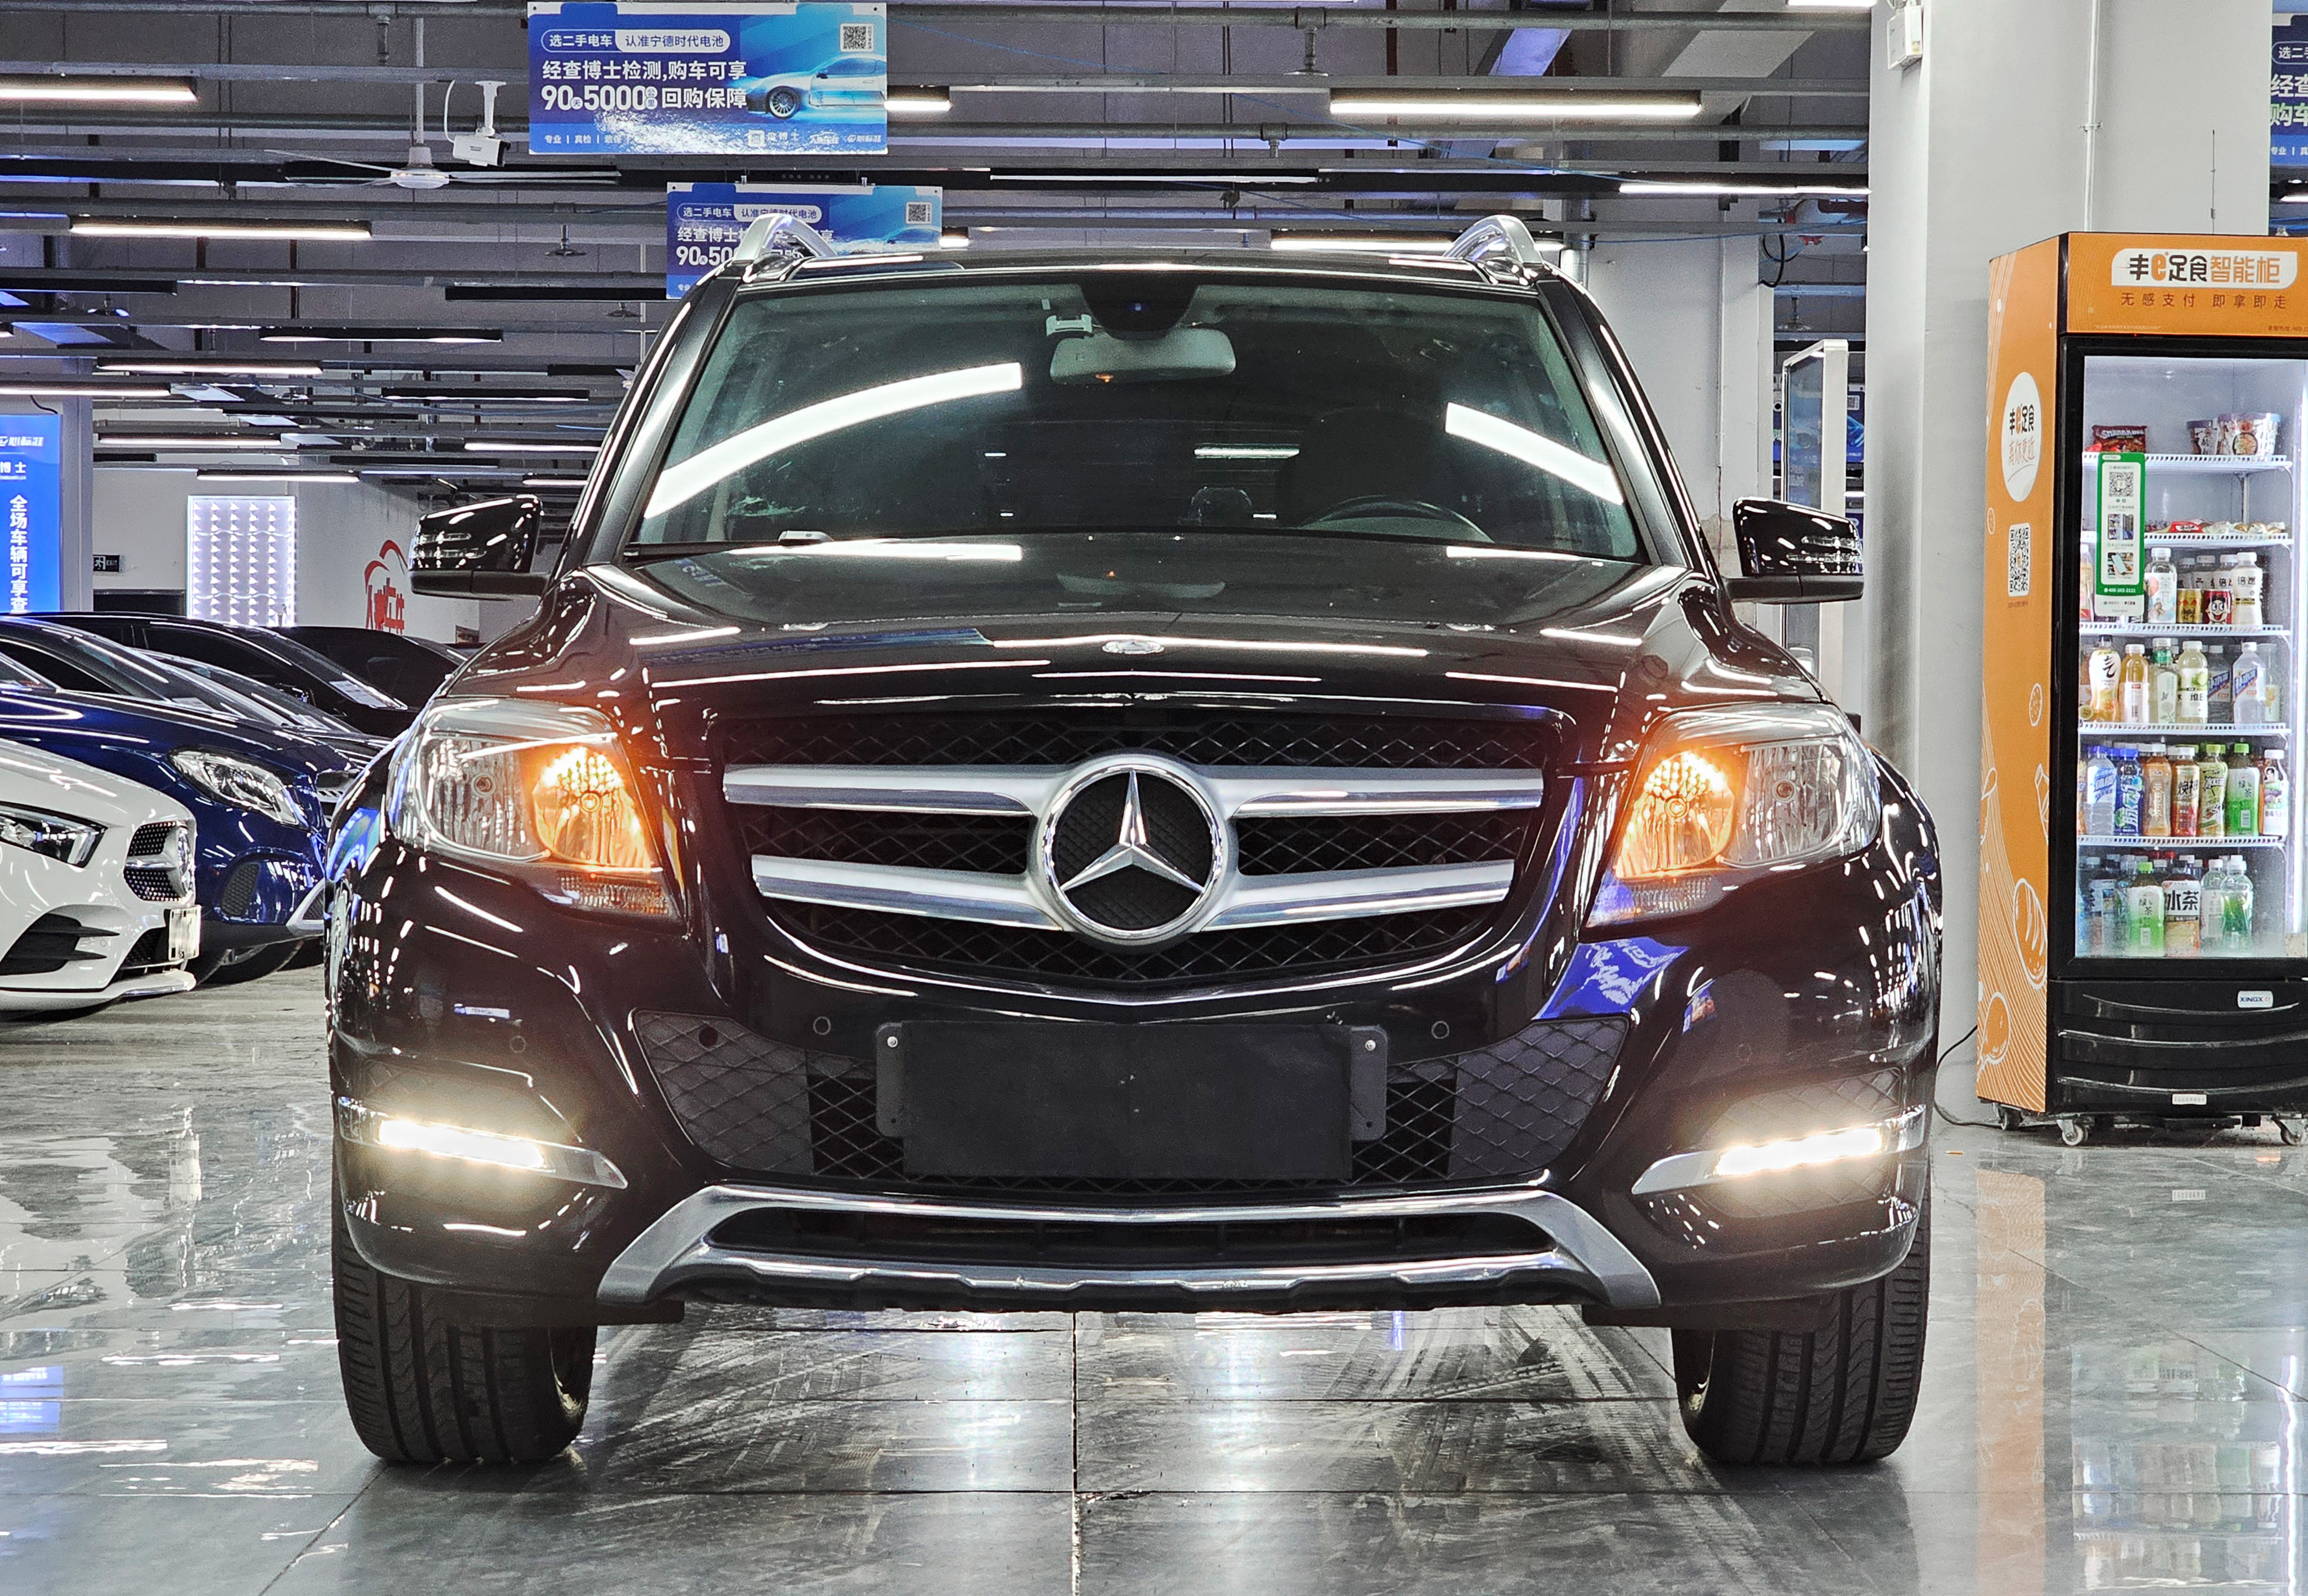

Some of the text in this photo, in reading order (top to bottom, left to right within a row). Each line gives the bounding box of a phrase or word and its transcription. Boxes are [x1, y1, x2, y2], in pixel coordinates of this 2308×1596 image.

[549, 34, 724, 47] 选二手电车 认准宁德时代电池
[542, 60, 747, 81] 经查博士检测,购车可享
[662, 87, 747, 109] 回购保障
[544, 135, 561, 144] 专业
[683, 207, 731, 217] 选二手电车
[676, 246, 740, 266] 90天50
[2120, 292, 2287, 310] 无感支付 即拿即走
[10, 495, 28, 613] 全场车辆可享查
